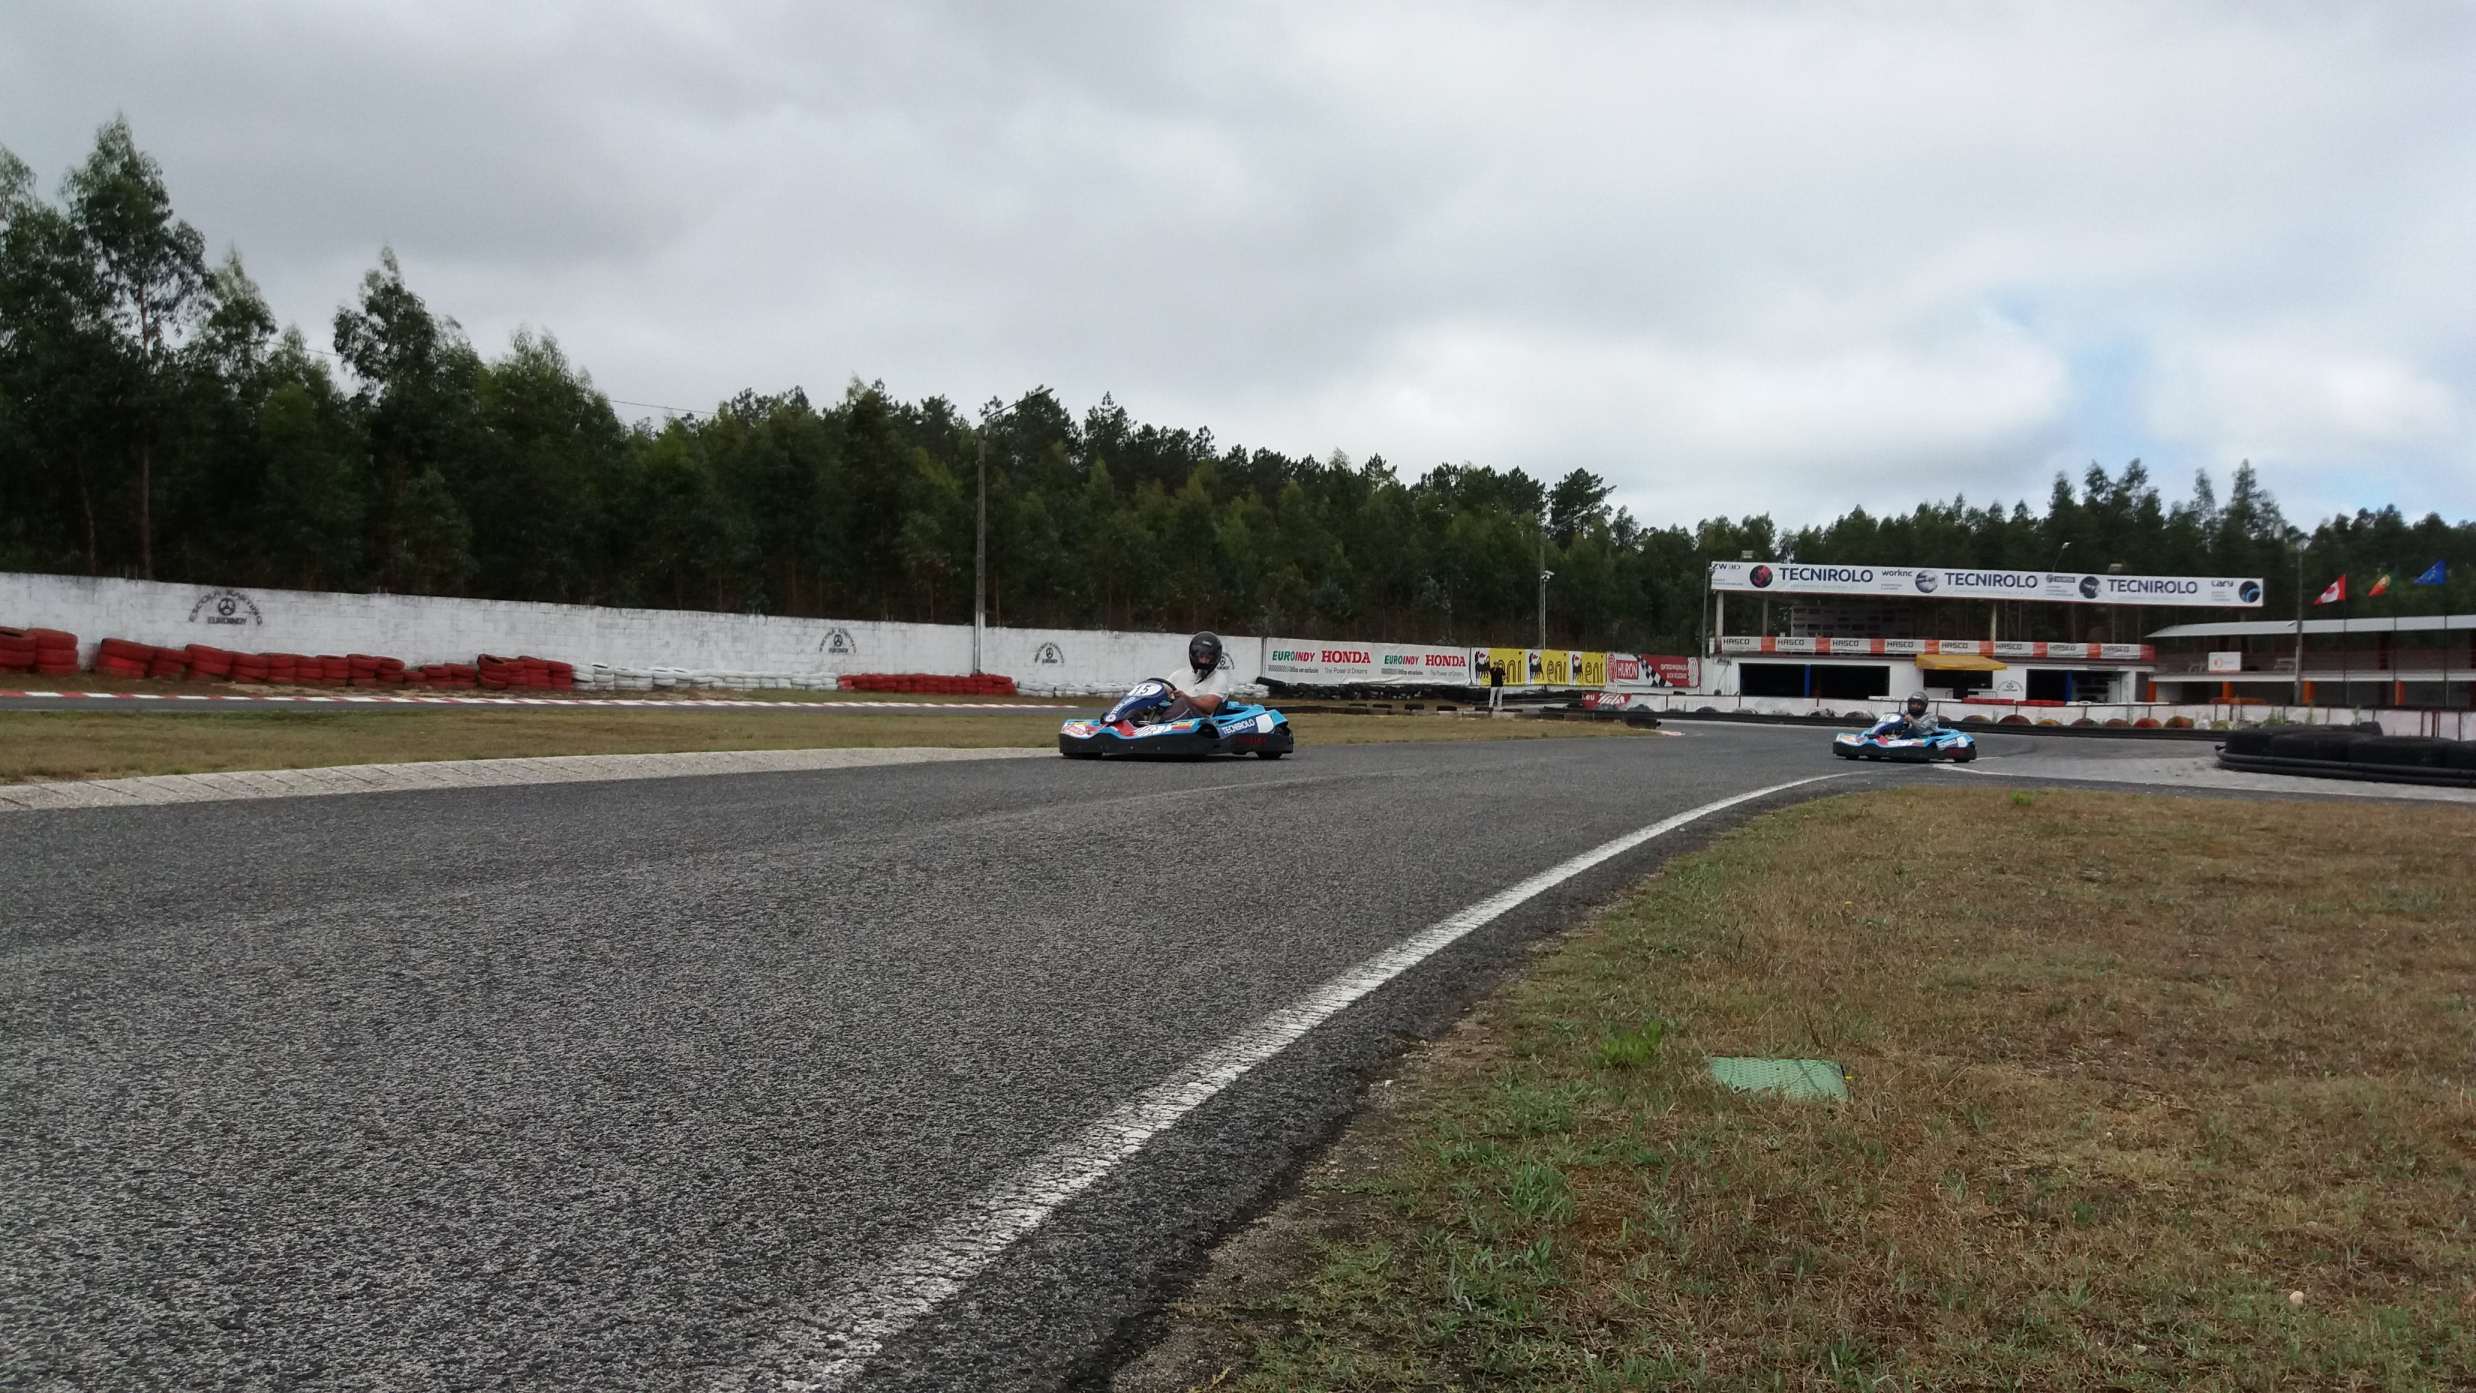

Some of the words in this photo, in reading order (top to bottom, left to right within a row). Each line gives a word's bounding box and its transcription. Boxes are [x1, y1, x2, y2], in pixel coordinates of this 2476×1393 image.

[1779, 567, 1873, 583] TECNIROLO
[1881, 569, 1913, 577] worknc
[1945, 572, 2038, 588] TECNIROLO
[2107, 579, 2198, 594] TECNIROLO
[1272, 650, 1315, 662] EUROINDY
[1321, 650, 1371, 664] HONDA
[1425, 654, 1467, 667] HONDA
[1547, 652, 1567, 683] eni
[1585, 654, 1604, 684] eni
